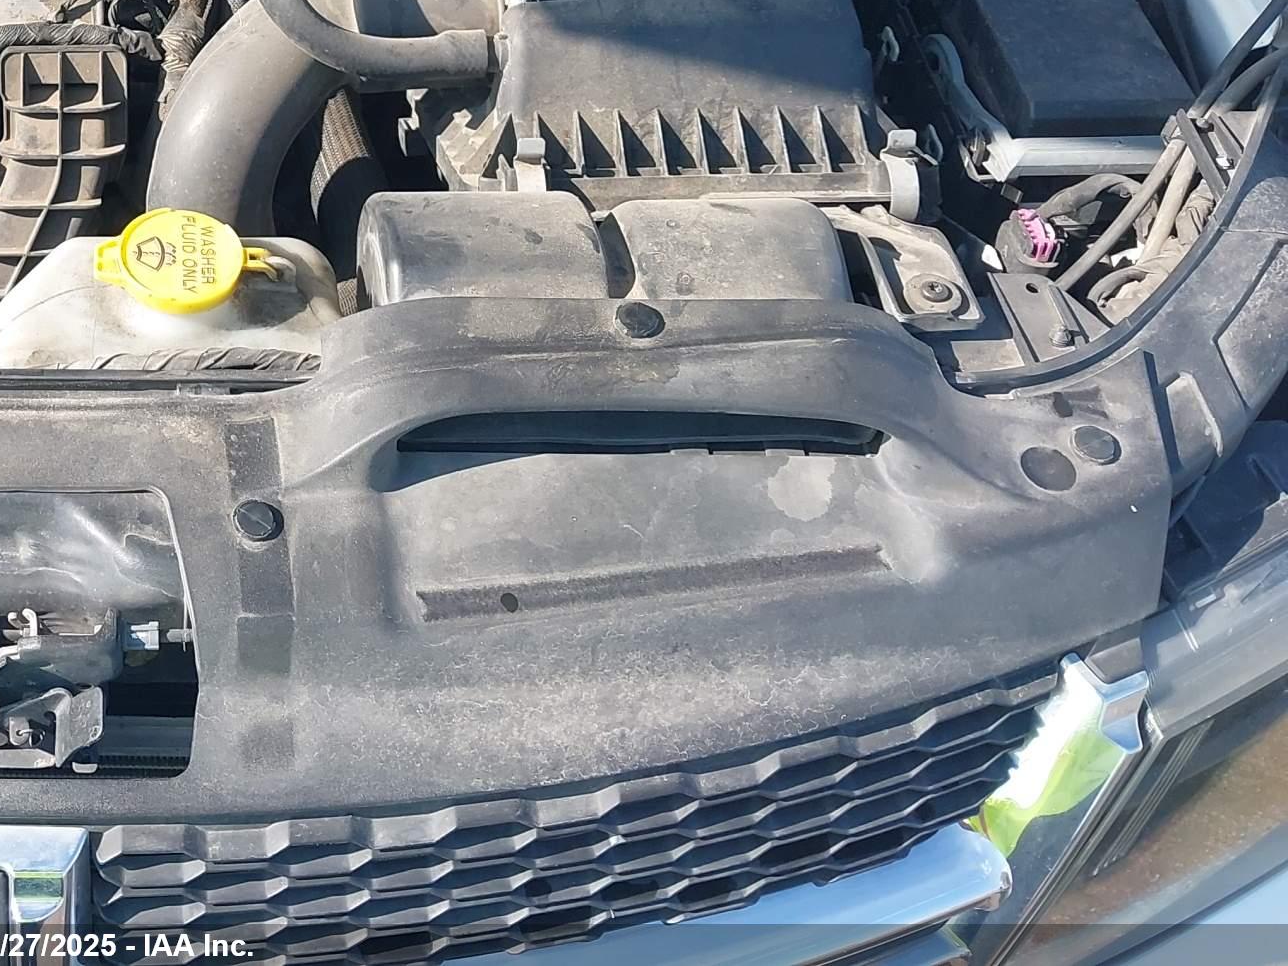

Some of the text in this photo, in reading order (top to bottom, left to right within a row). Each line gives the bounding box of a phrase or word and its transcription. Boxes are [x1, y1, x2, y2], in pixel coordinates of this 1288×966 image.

[182, 215, 198, 294] FLUID ONLY
[200, 226, 216, 285] WASHER
